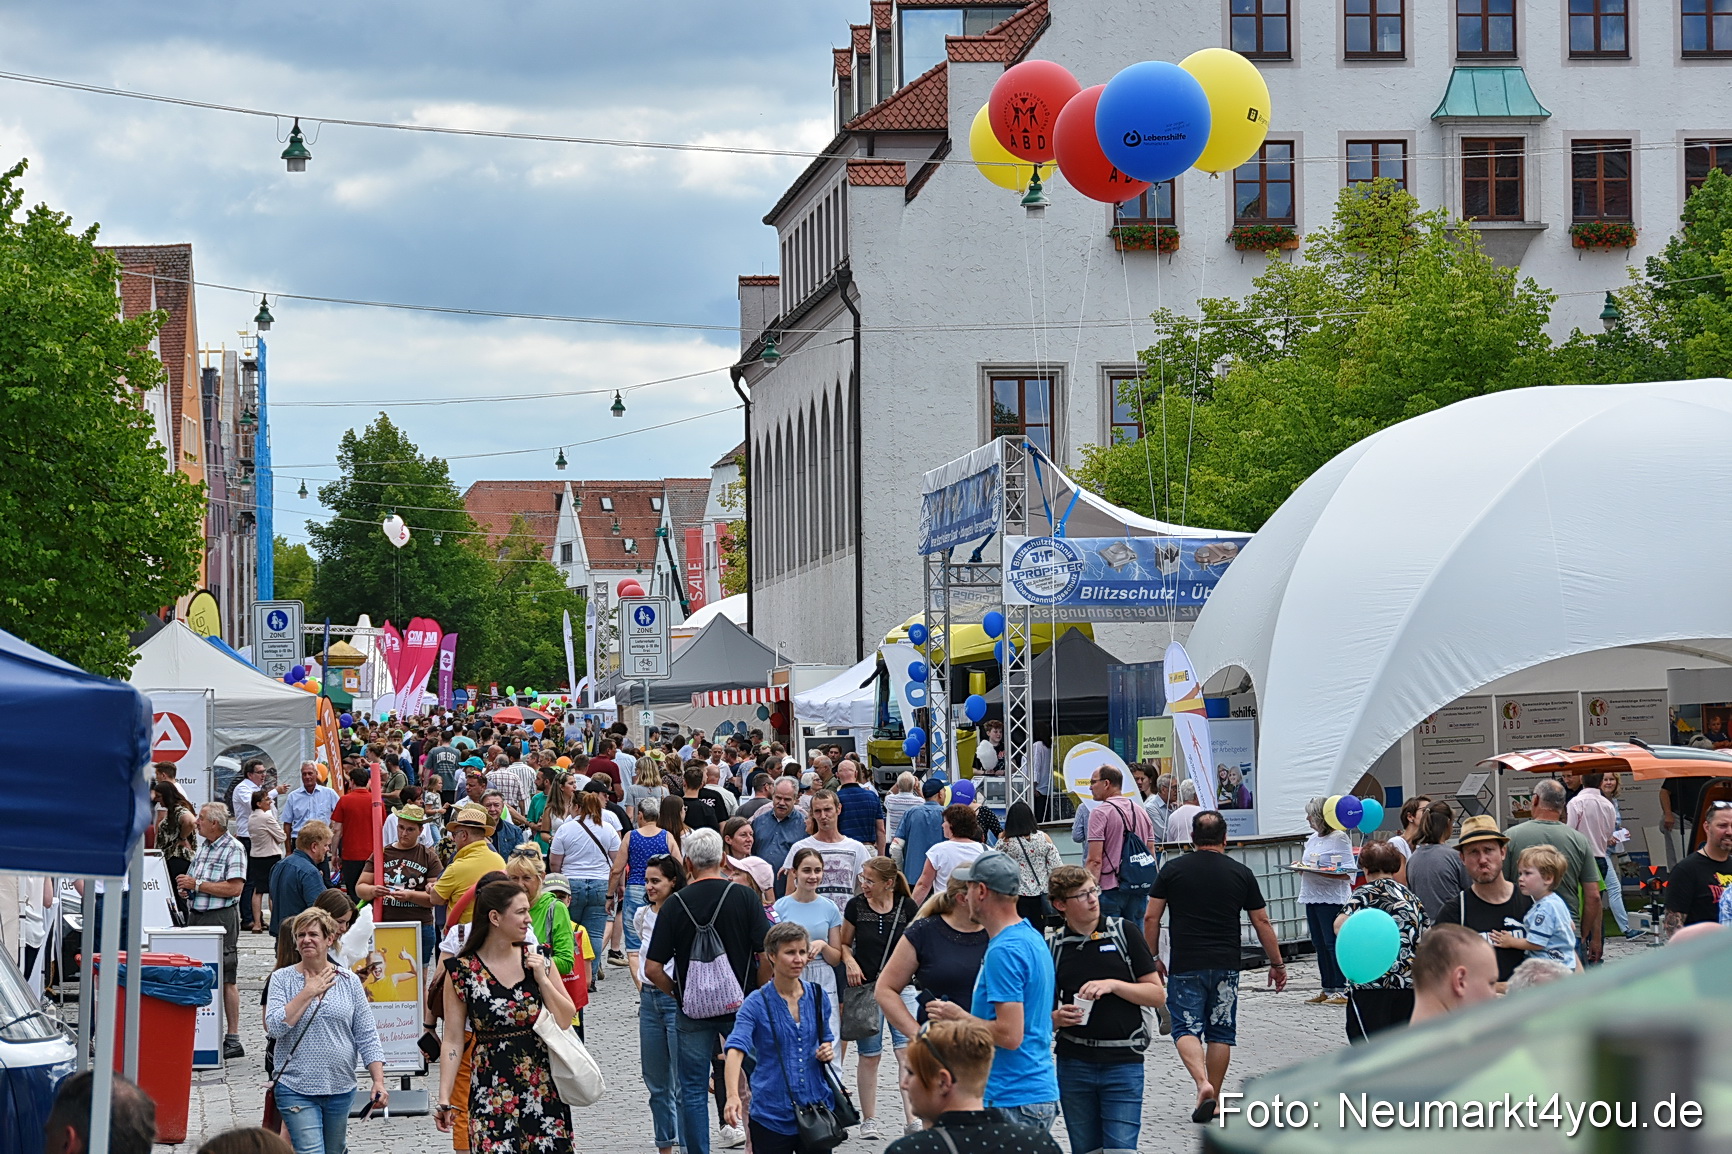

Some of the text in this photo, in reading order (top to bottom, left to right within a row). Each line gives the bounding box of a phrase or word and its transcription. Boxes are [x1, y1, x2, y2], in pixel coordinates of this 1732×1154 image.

[1143, 133, 1187, 141] Lebenshilfe
[1012, 538, 1074, 567] Blitzschutztechnik
[1008, 562, 1084, 582] J.PRÖPSTER
[688, 563, 703, 602] SALE
[1080, 586, 1175, 600] Blitzschutz
[415, 685, 425, 707] ZUKUNFT
[1219, 746, 1248, 754] Arbeitgeber
[401, 1002, 418, 1011] Folge!
[396, 1015, 414, 1028] Dank
[391, 1030, 420, 1042] Vertrauen
